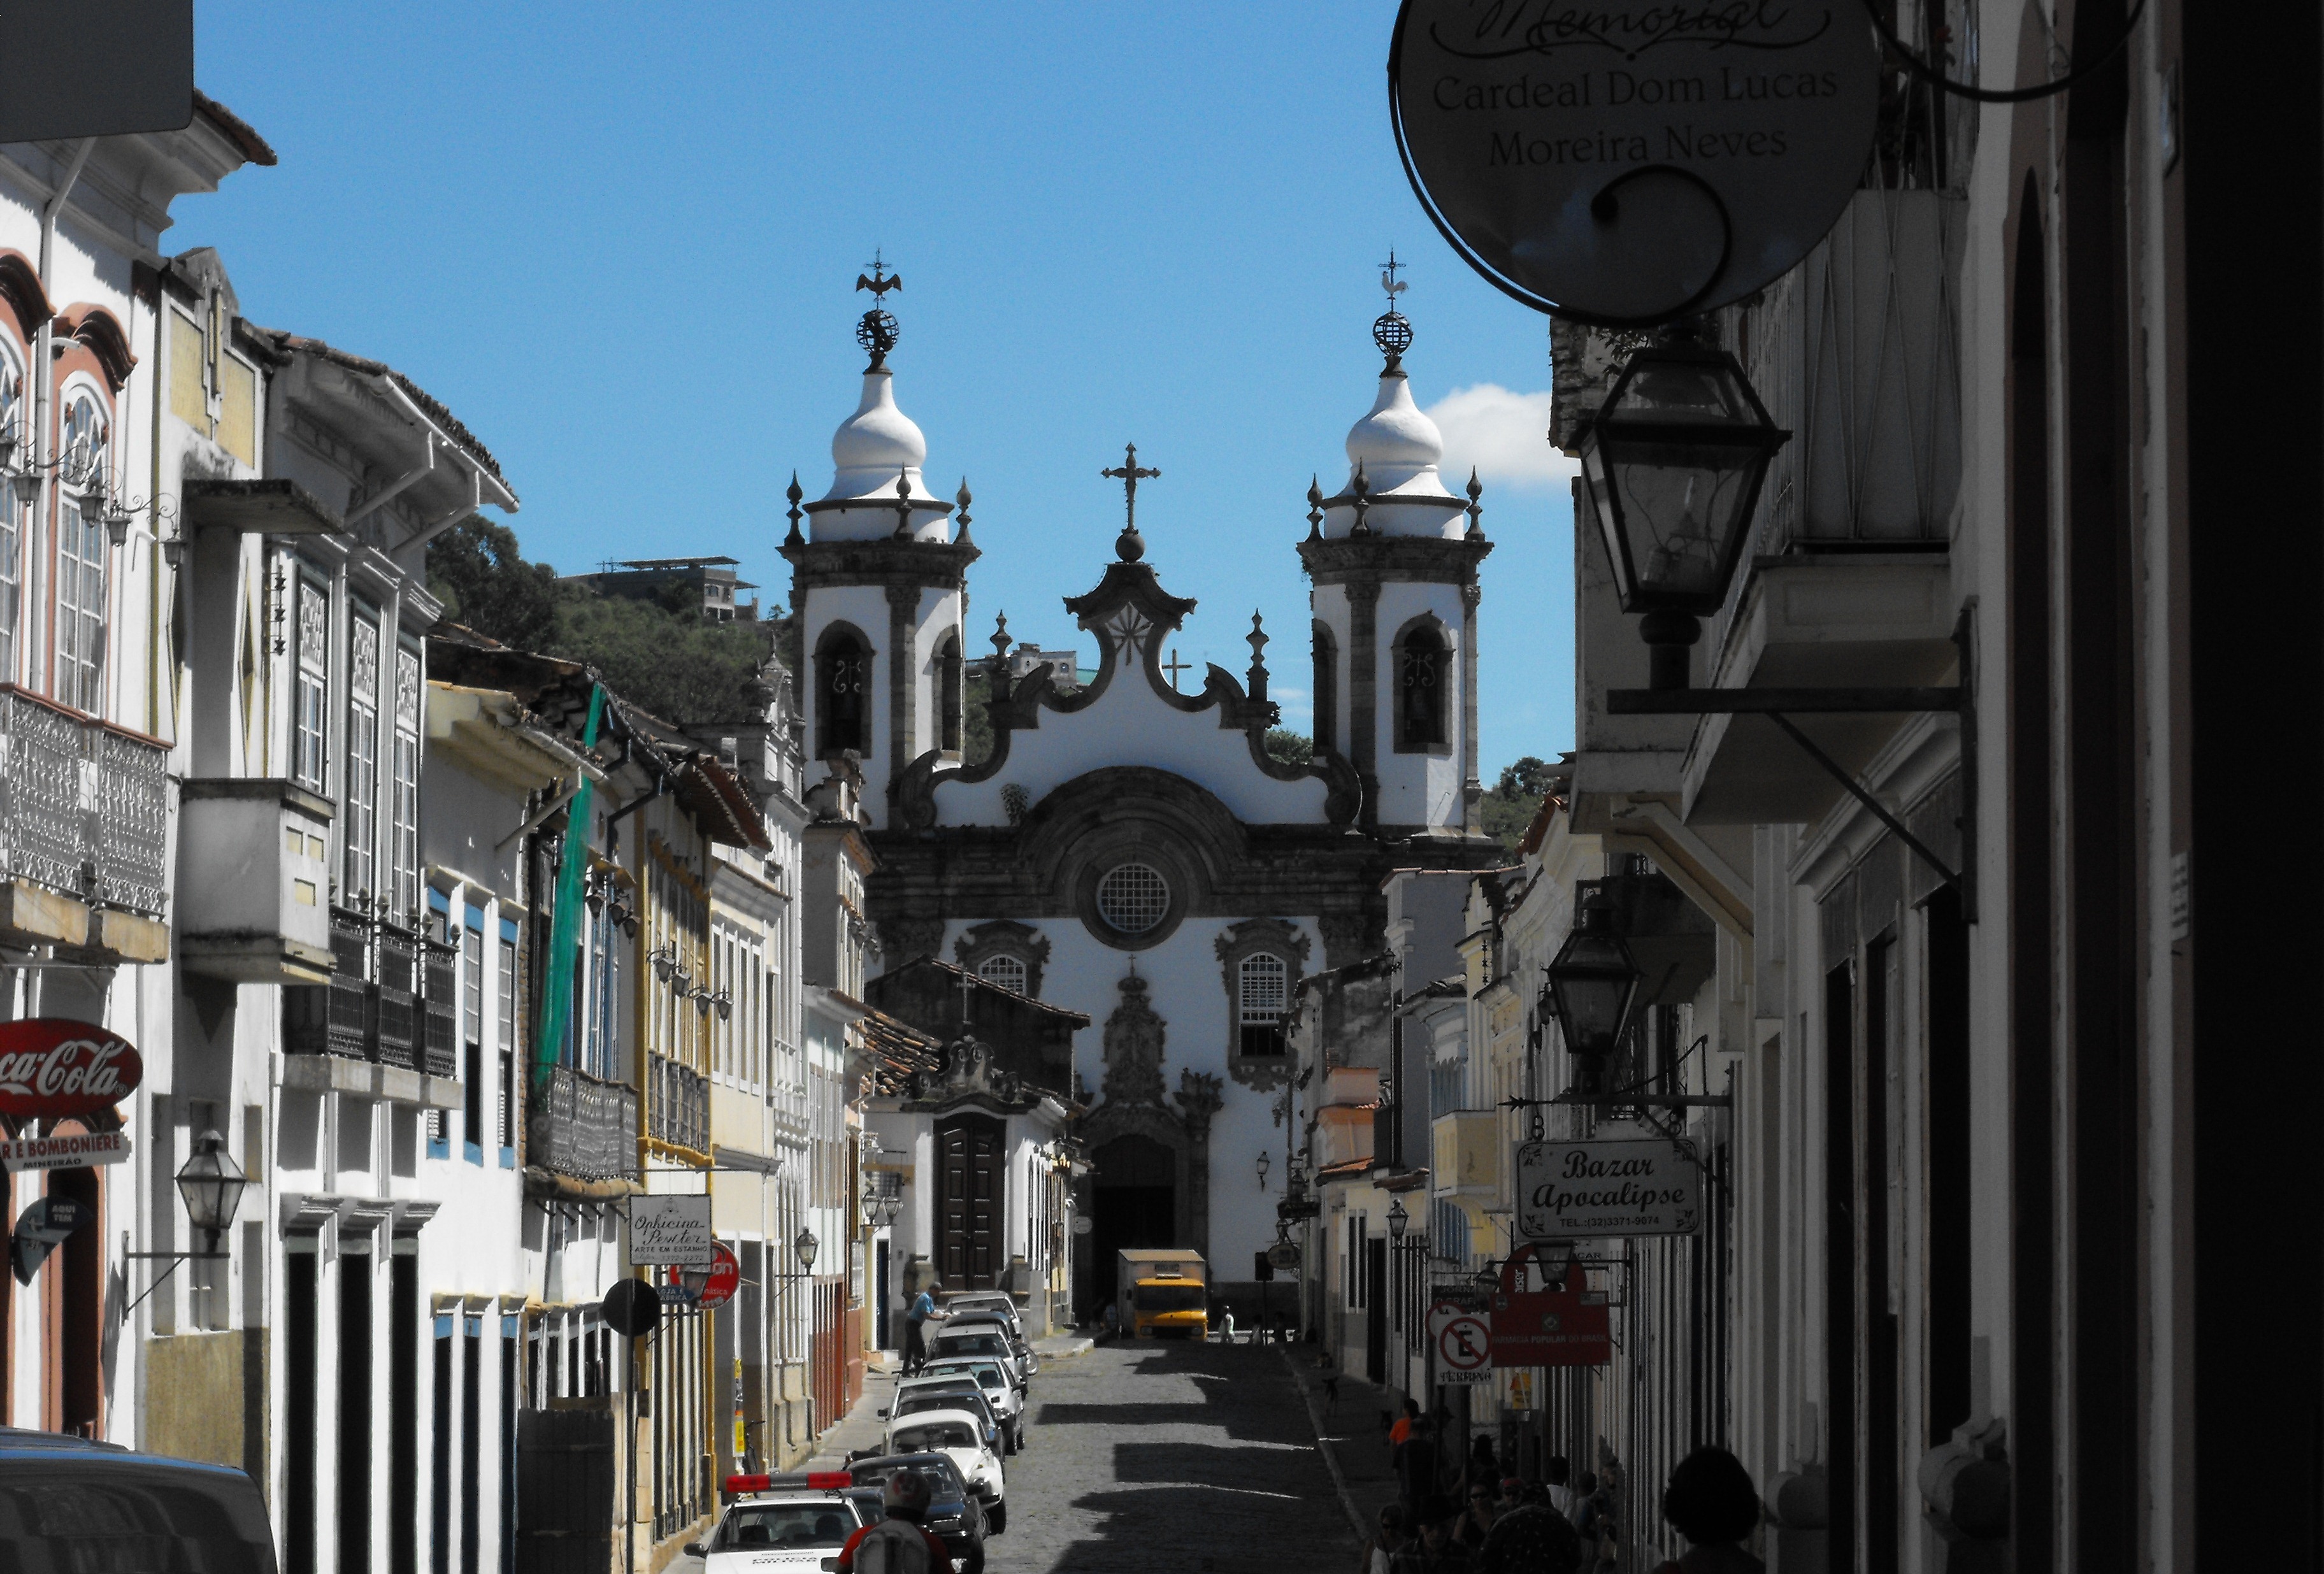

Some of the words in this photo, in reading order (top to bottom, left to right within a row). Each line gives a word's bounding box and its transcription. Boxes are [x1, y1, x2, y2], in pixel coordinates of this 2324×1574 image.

[1433, 73, 1591, 111] Cardeal
[1608, 70, 1707, 106] Dom
[1721, 66, 1838, 101] Lucas
[1489, 130, 1648, 166] Moreira
[1664, 124, 1788, 159] Neves
[16, 1142, 24, 1159] E
[27, 1133, 121, 1157] BOMBONIERE
[1562, 1150, 1654, 1179] Bazar
[1531, 1182, 1686, 1215] Apocalipse
[634, 1213, 705, 1236] Ophicina
[1531, 1334, 1567, 1343] POPULAR
